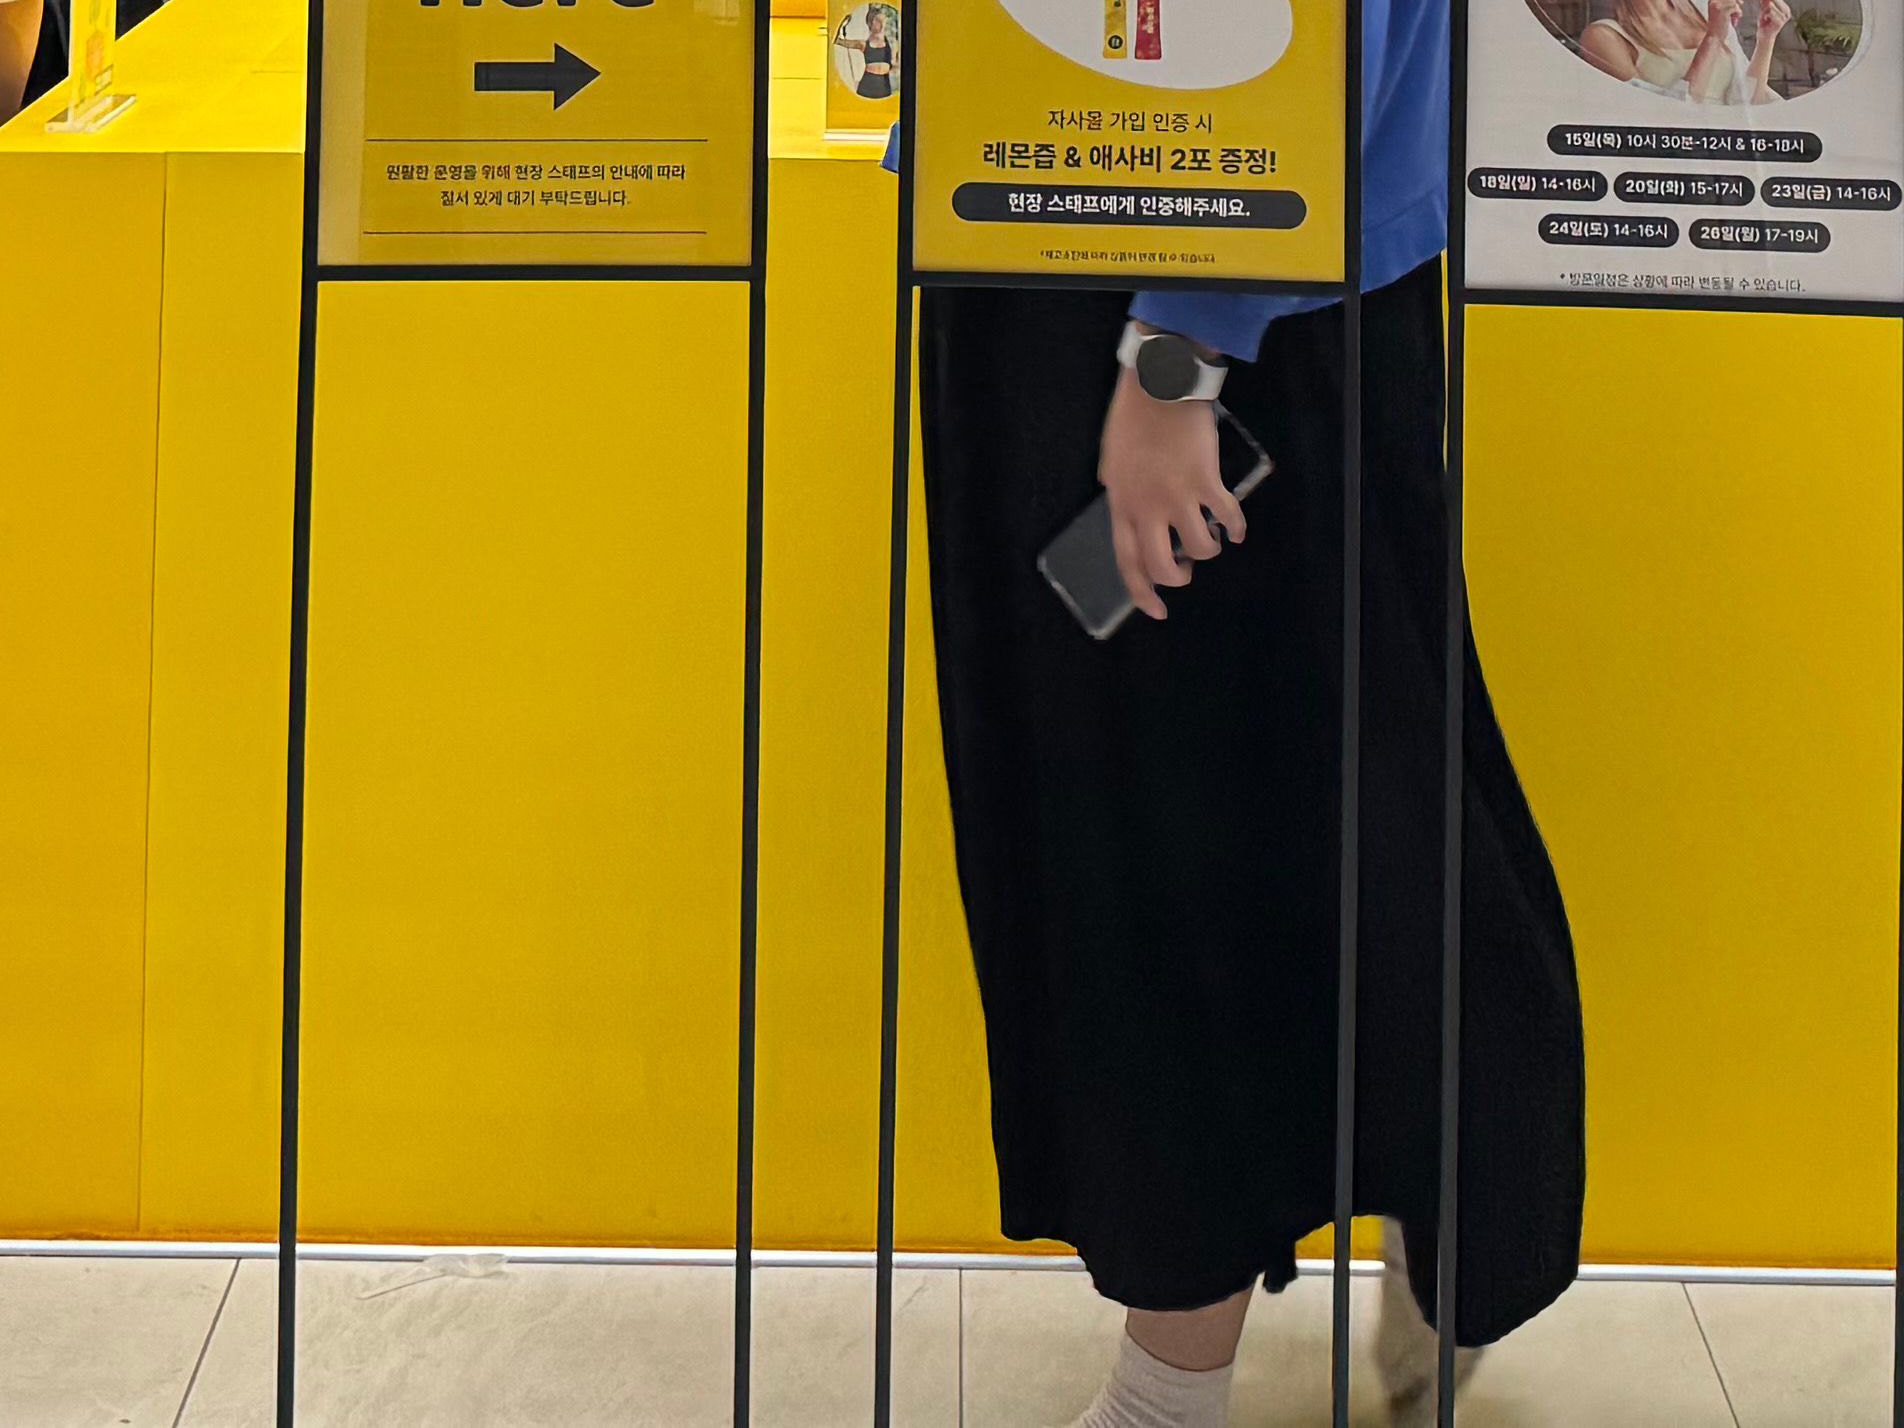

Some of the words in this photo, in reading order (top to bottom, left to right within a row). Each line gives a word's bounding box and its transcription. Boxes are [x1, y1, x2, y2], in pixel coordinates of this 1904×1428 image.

[1048, 109, 1102, 131] 자사몰
[1110, 111, 1145, 132] 가입
[1153, 112, 1189, 133] 인증
[1195, 113, 1213, 134] 시
[1627, 133, 1656, 149] 10시
[1735, 139, 1745, 151] &
[983, 142, 1056, 169] 레몬즙
[1064, 145, 1082, 169] &
[1089, 144, 1162, 173] 애사비
[1170, 148, 1213, 173] 2포
[1218, 148, 1277, 174] 증정!
[515, 165, 543, 180] 현장
[548, 165, 605, 180] 스태프의
[657, 165, 686, 180] 따라
[1690, 181, 1743, 197] 15-17시
[1771, 184, 1831, 201] 23일(금)
[1836, 186, 1891, 201] 14-16시
[474, 190, 502, 206] 있게
[507, 190, 535, 206] 대기
[1008, 192, 1041, 213] 현장
[1047, 194, 1135, 216] 스태프에게
[1140, 197, 1251, 218] 인증해주세요.
[1549, 221, 1609, 237] 24일(토)
[1614, 223, 1668, 239] 14-16시
[1765, 228, 1818, 244] 17-19시
[1671, 275, 1695, 289] 따라
[1739, 278, 1750, 291] 수
